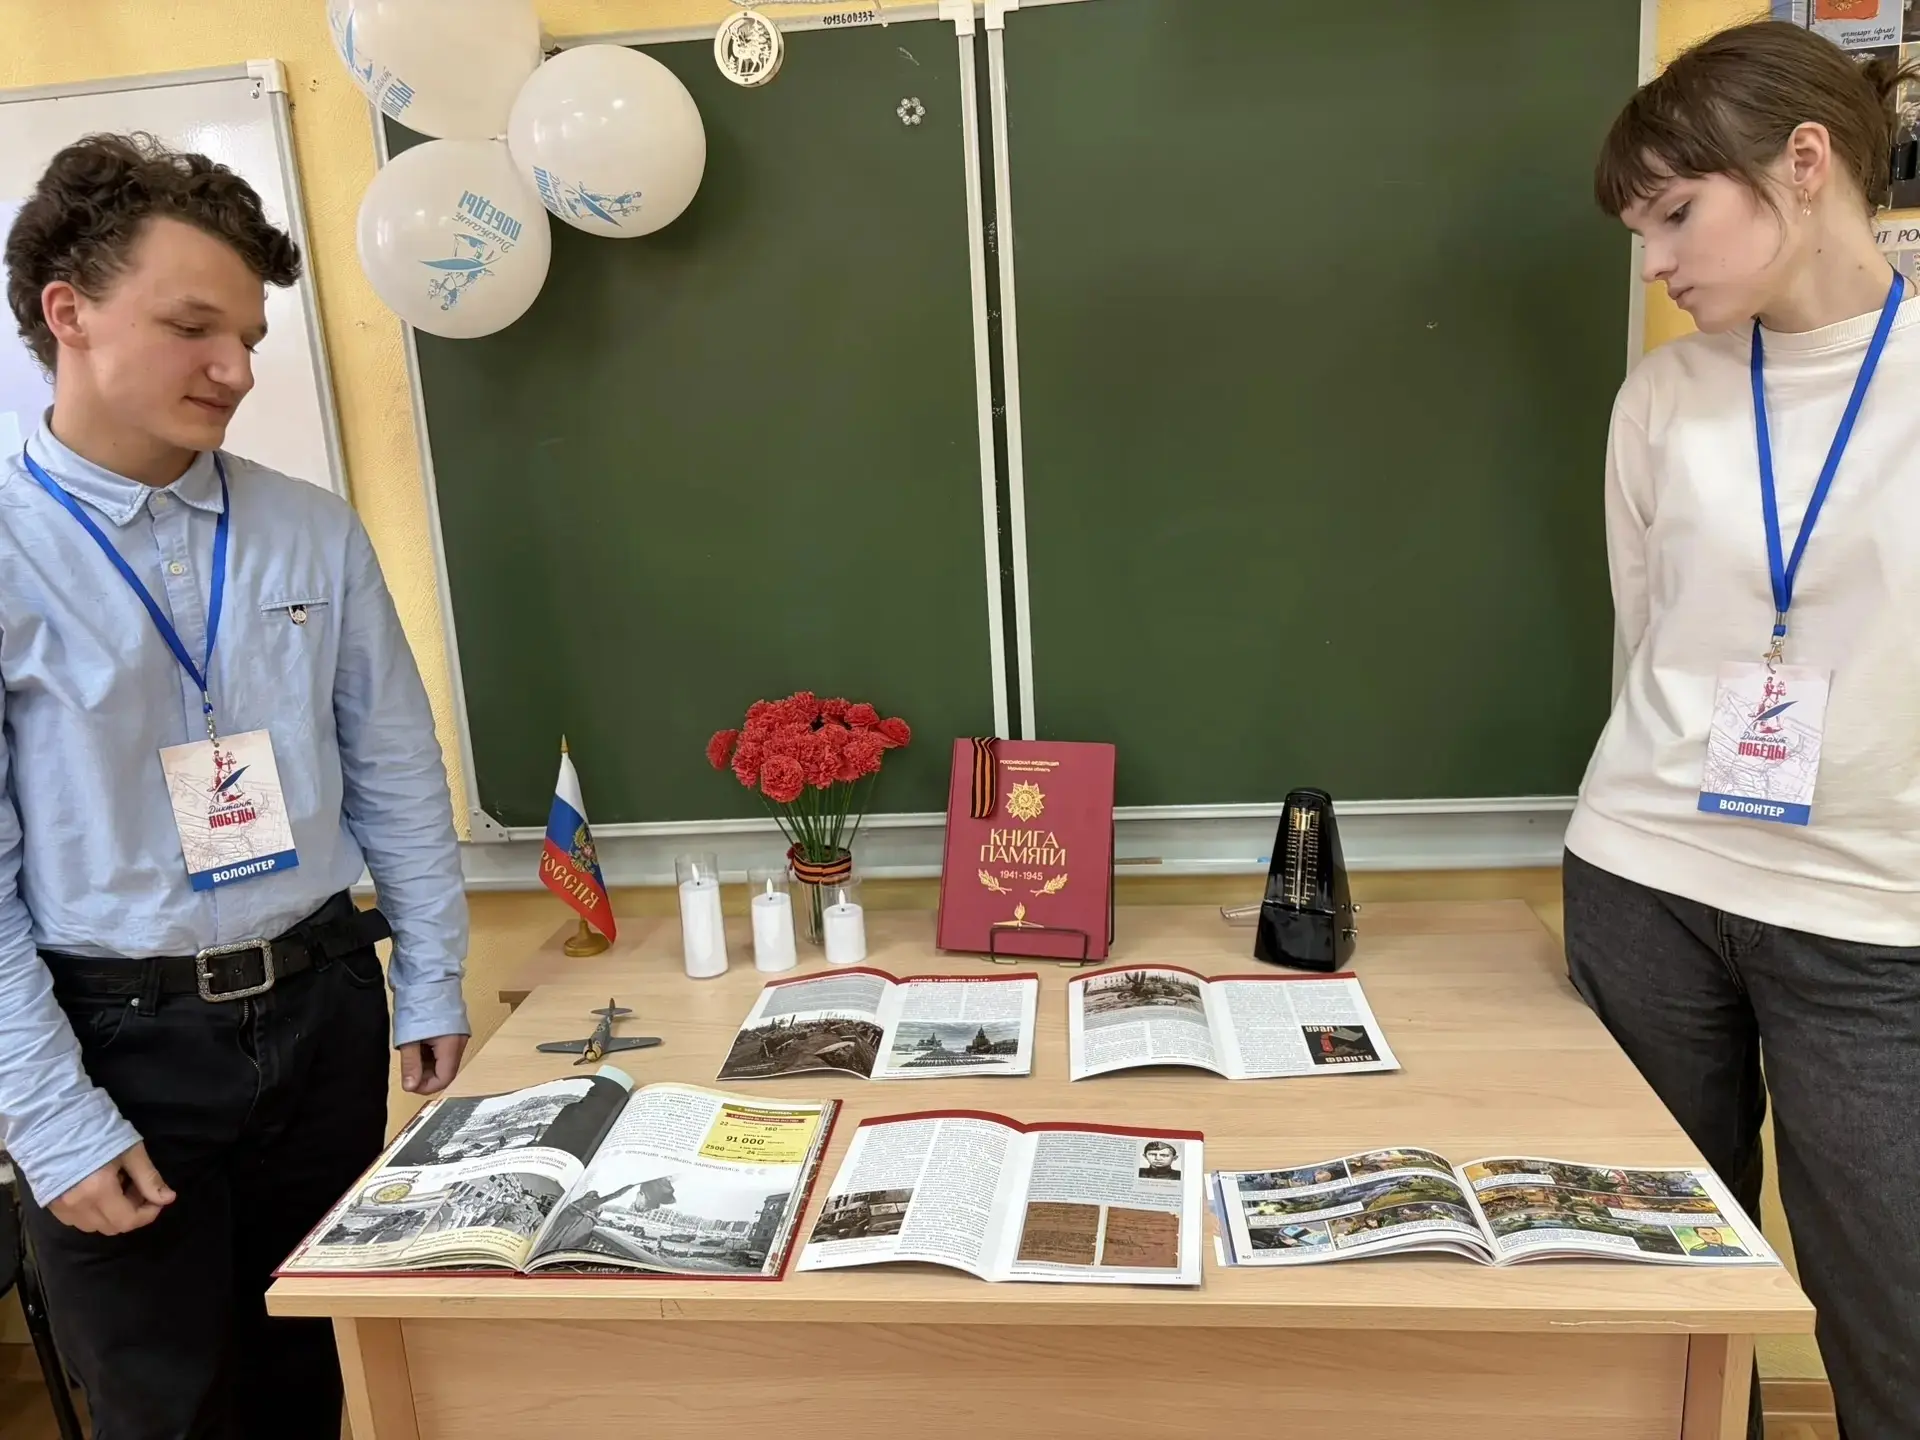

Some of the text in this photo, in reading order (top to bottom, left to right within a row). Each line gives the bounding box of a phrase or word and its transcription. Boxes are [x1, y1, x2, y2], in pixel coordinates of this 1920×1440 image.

[823, 11, 875, 25] 1013600337
[458, 190, 522, 241] ПОБЕДЫ
[452, 212, 515, 253] Диктант
[1898, 228, 1920, 243] РО
[1740, 731, 1788, 745] Диктант
[1738, 742, 1787, 760] ПОБЕДЫ
[208, 798, 253, 814] Диктант
[1719, 799, 1785, 818] ВОЛОНТЕР
[208, 806, 257, 829] ПОБЕДЫ
[990, 828, 1059, 848] КНИГА
[980, 844, 1066, 866] ПАМЯТИ
[212, 859, 276, 883] ВОЛОНТЕР
[541, 850, 600, 910] РОССИЯ
[1000, 870, 1043, 881] 1941-1945
[725, 1135, 738, 1143] 91
[741, 1137, 765, 1146] 000
